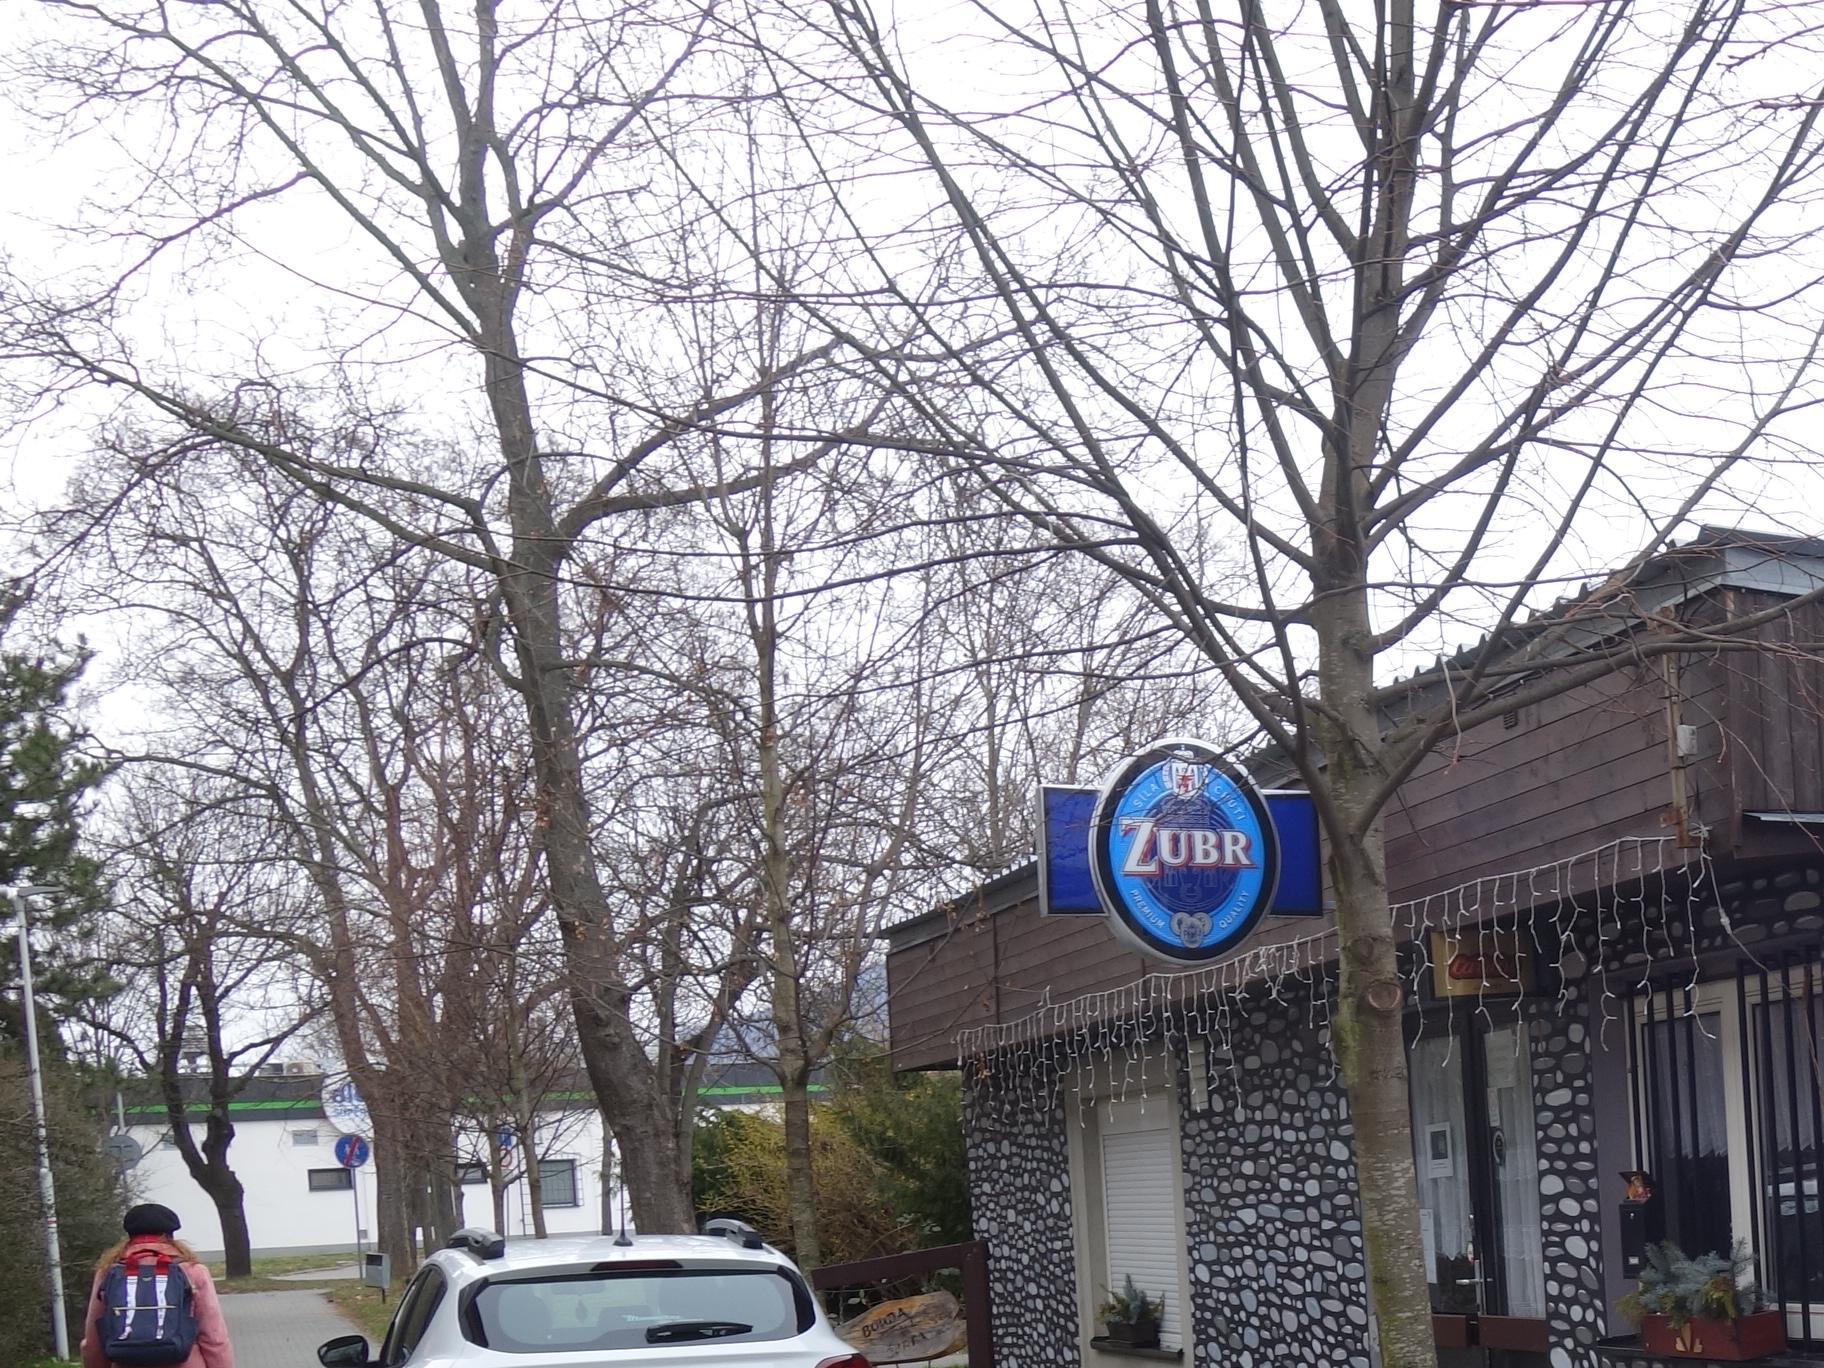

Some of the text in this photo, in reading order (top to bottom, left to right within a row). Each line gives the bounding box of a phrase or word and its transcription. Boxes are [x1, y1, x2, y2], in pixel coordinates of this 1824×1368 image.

[1119, 815, 1257, 877] ZUBR
[1129, 888, 1250, 930] PREMIUM QUALITY
